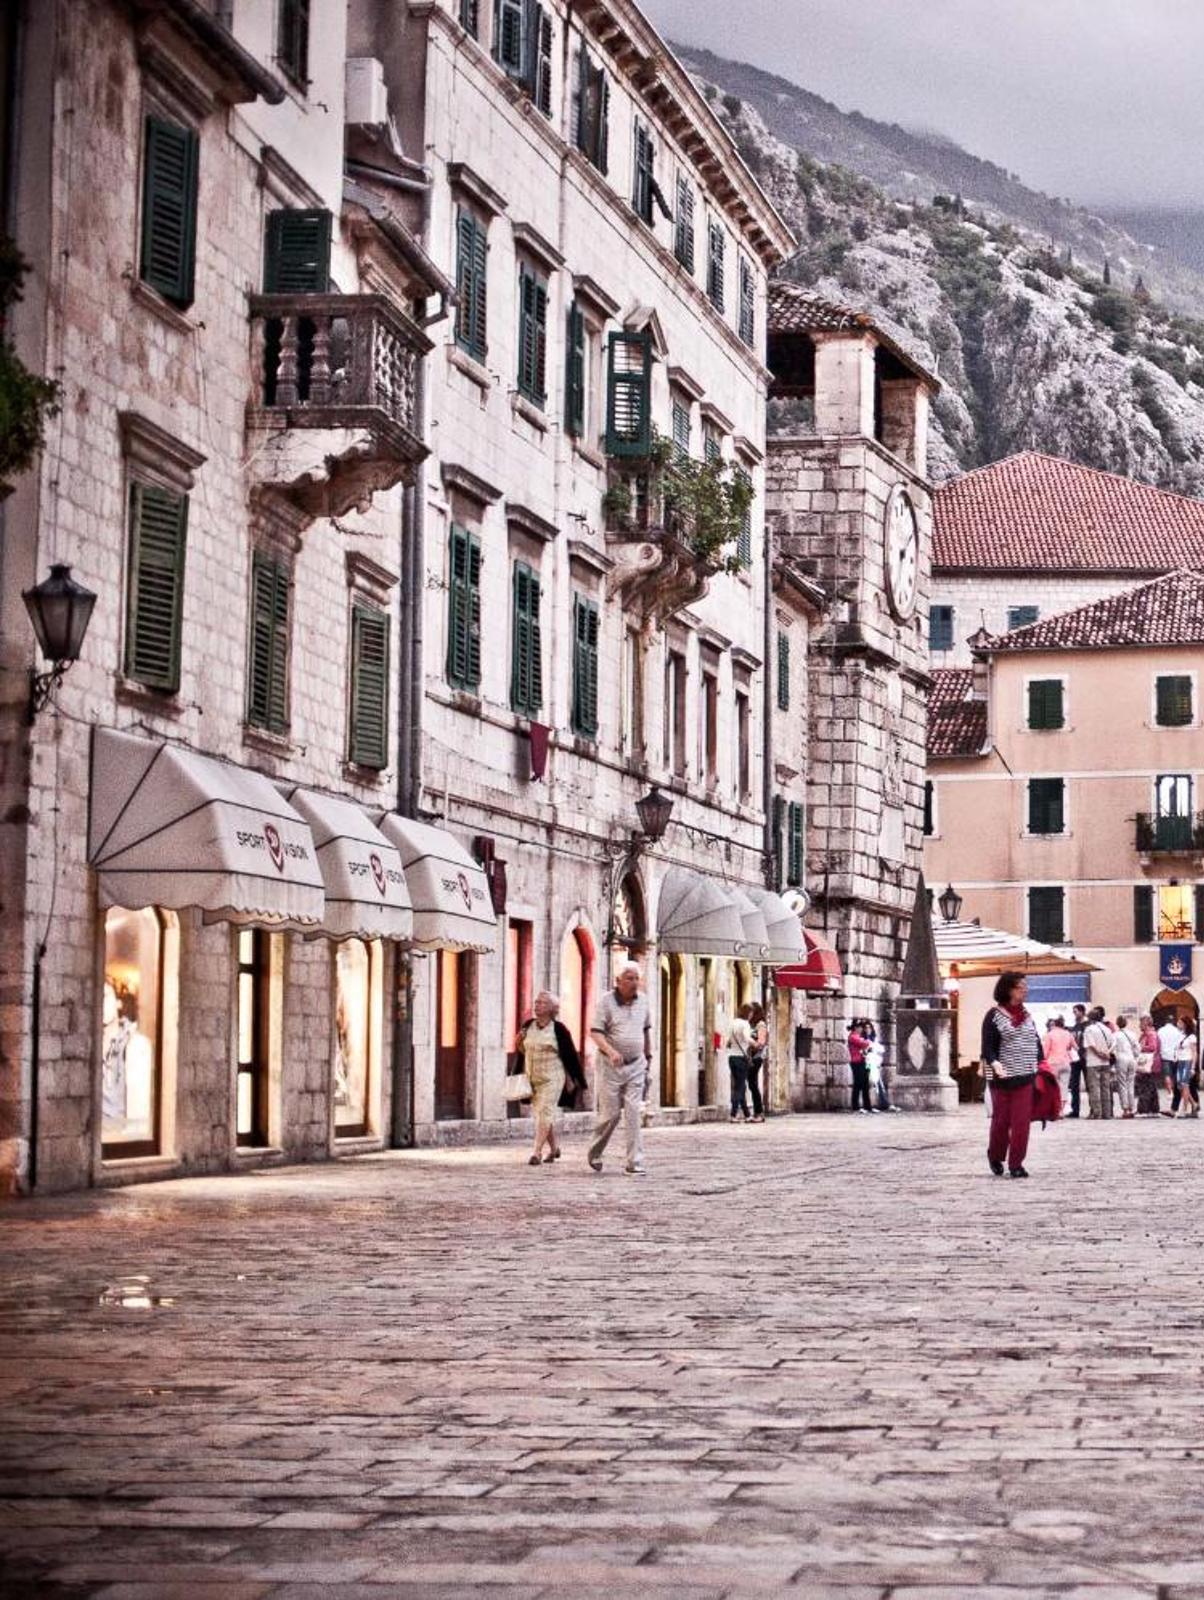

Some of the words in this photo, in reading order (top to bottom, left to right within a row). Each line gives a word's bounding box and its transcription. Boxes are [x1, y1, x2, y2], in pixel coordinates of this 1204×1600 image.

[236, 831, 265, 849] SPORT
[281, 842, 310, 860] VISION
[347, 861, 370, 876] SPORT
